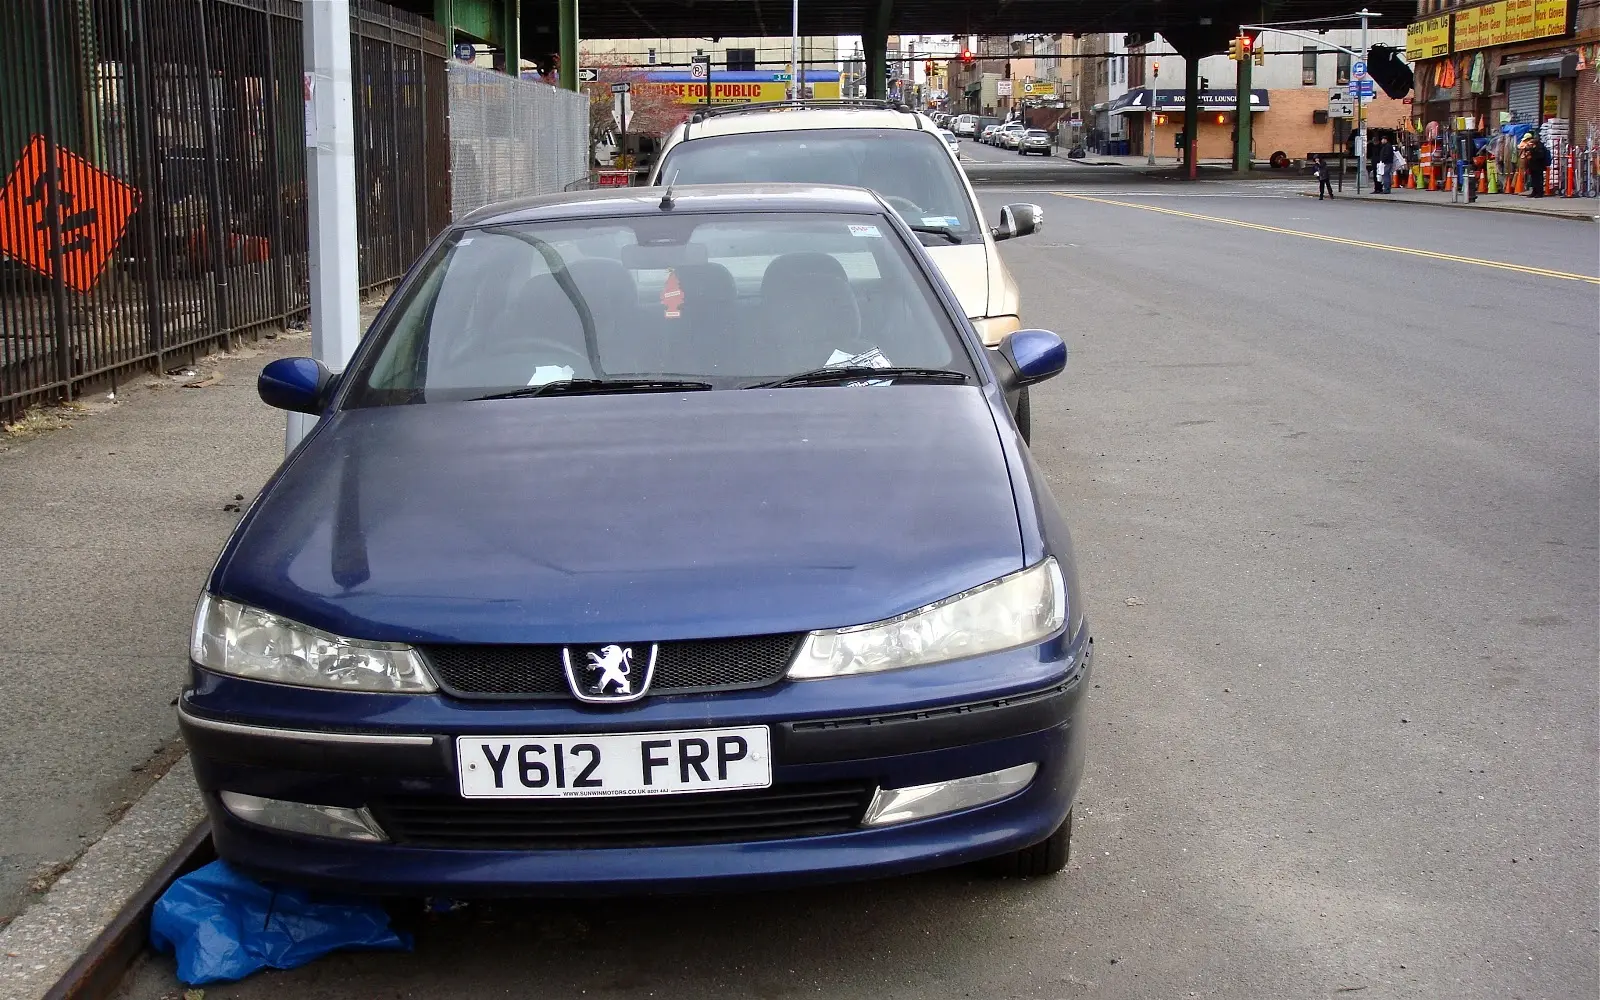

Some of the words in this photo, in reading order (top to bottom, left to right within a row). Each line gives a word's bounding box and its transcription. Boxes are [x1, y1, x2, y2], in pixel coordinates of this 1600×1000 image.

[1549, 8, 1564, 18] Gloves
[1407, 22, 1424, 36] Safety
[1427, 19, 1439, 32] With
[1440, 16, 1448, 28] Us
[715, 83, 761, 97] PUBLIC
[481, 743, 603, 789] Y612
[640, 735, 748, 786] FRP
[563, 789, 646, 797] WWW.SUNWINMOTORS.CO.UK
